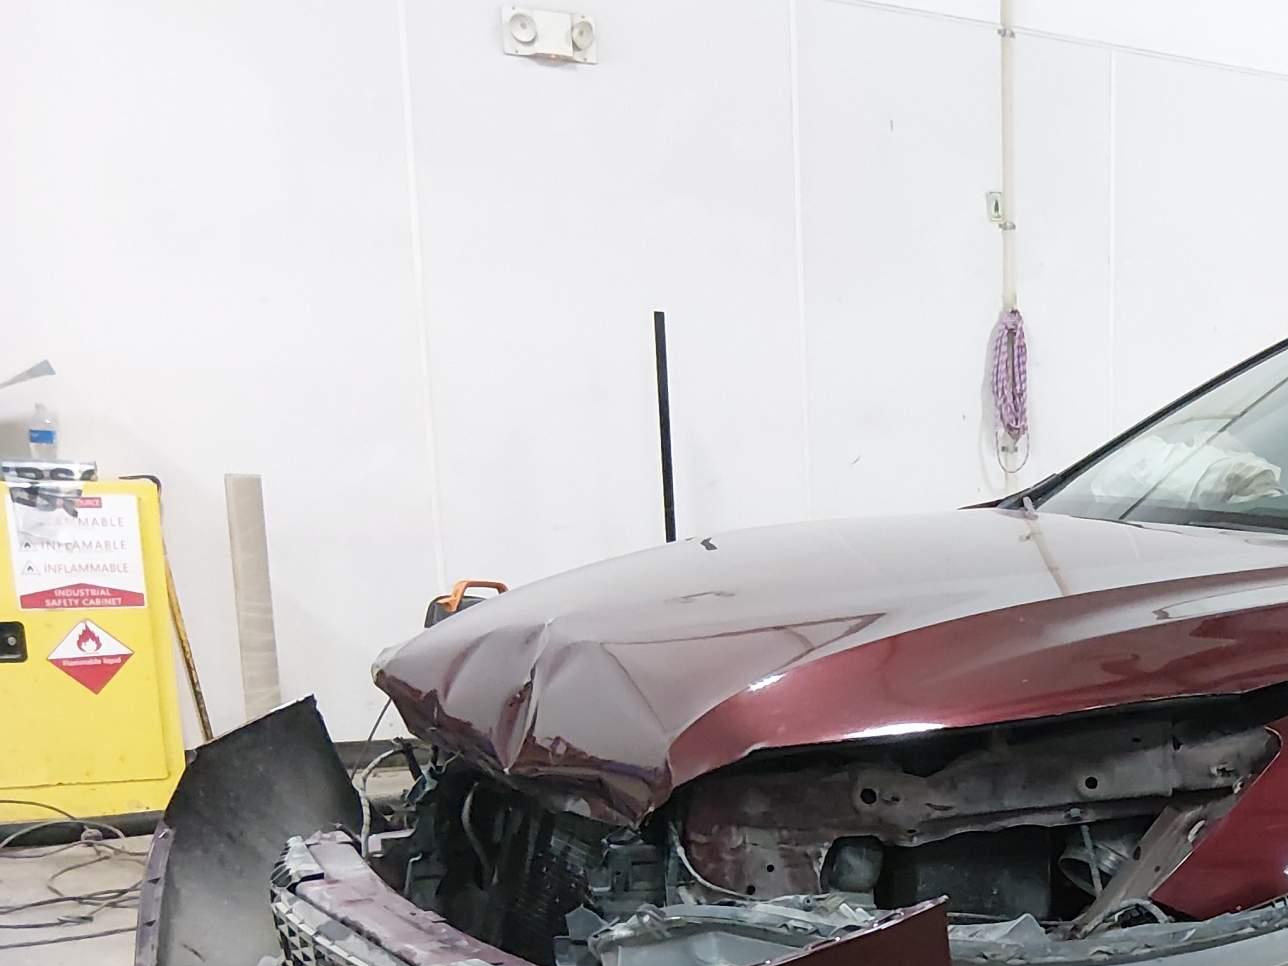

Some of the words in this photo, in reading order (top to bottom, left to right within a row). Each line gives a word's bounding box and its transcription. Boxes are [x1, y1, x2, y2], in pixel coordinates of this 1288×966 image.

[44, 562, 129, 573] INFLAMMABLE
[54, 588, 111, 597] INDUSTRIAL
[45, 598, 80, 607] SAFETY
[82, 597, 122, 606] CABINET
